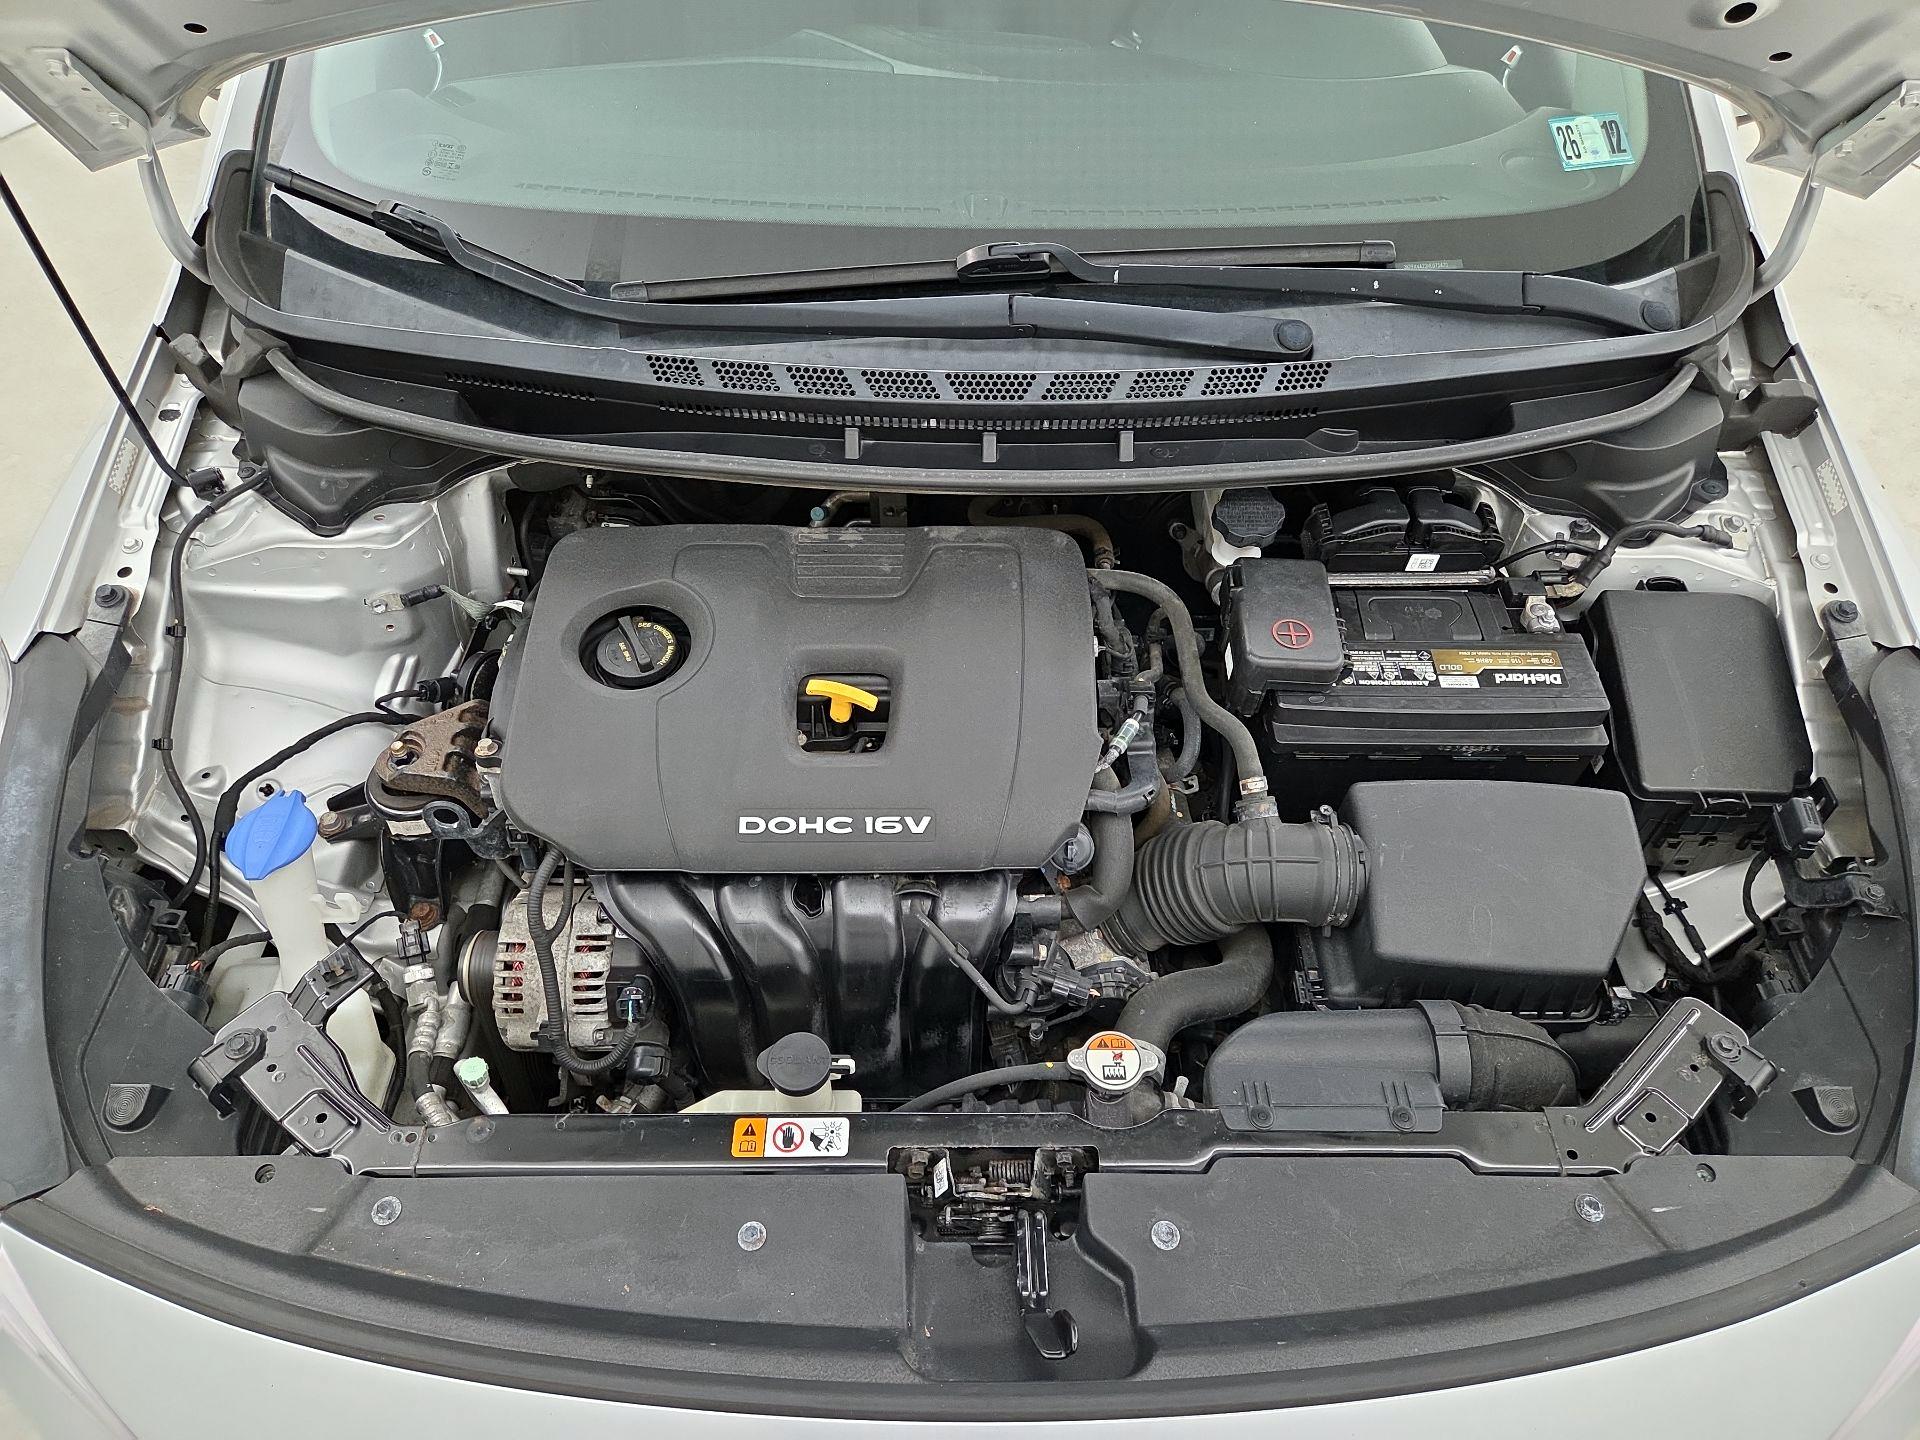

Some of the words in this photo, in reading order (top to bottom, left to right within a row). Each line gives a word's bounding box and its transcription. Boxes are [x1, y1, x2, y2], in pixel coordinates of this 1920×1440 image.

[1556, 125, 1581, 160] 26
[1600, 119, 1627, 155] 12
[656, 645, 675, 666] MANUAL
[1494, 673, 1562, 685] DieHard
[738, 816, 854, 834] DOHC
[864, 815, 932, 834] 16V
